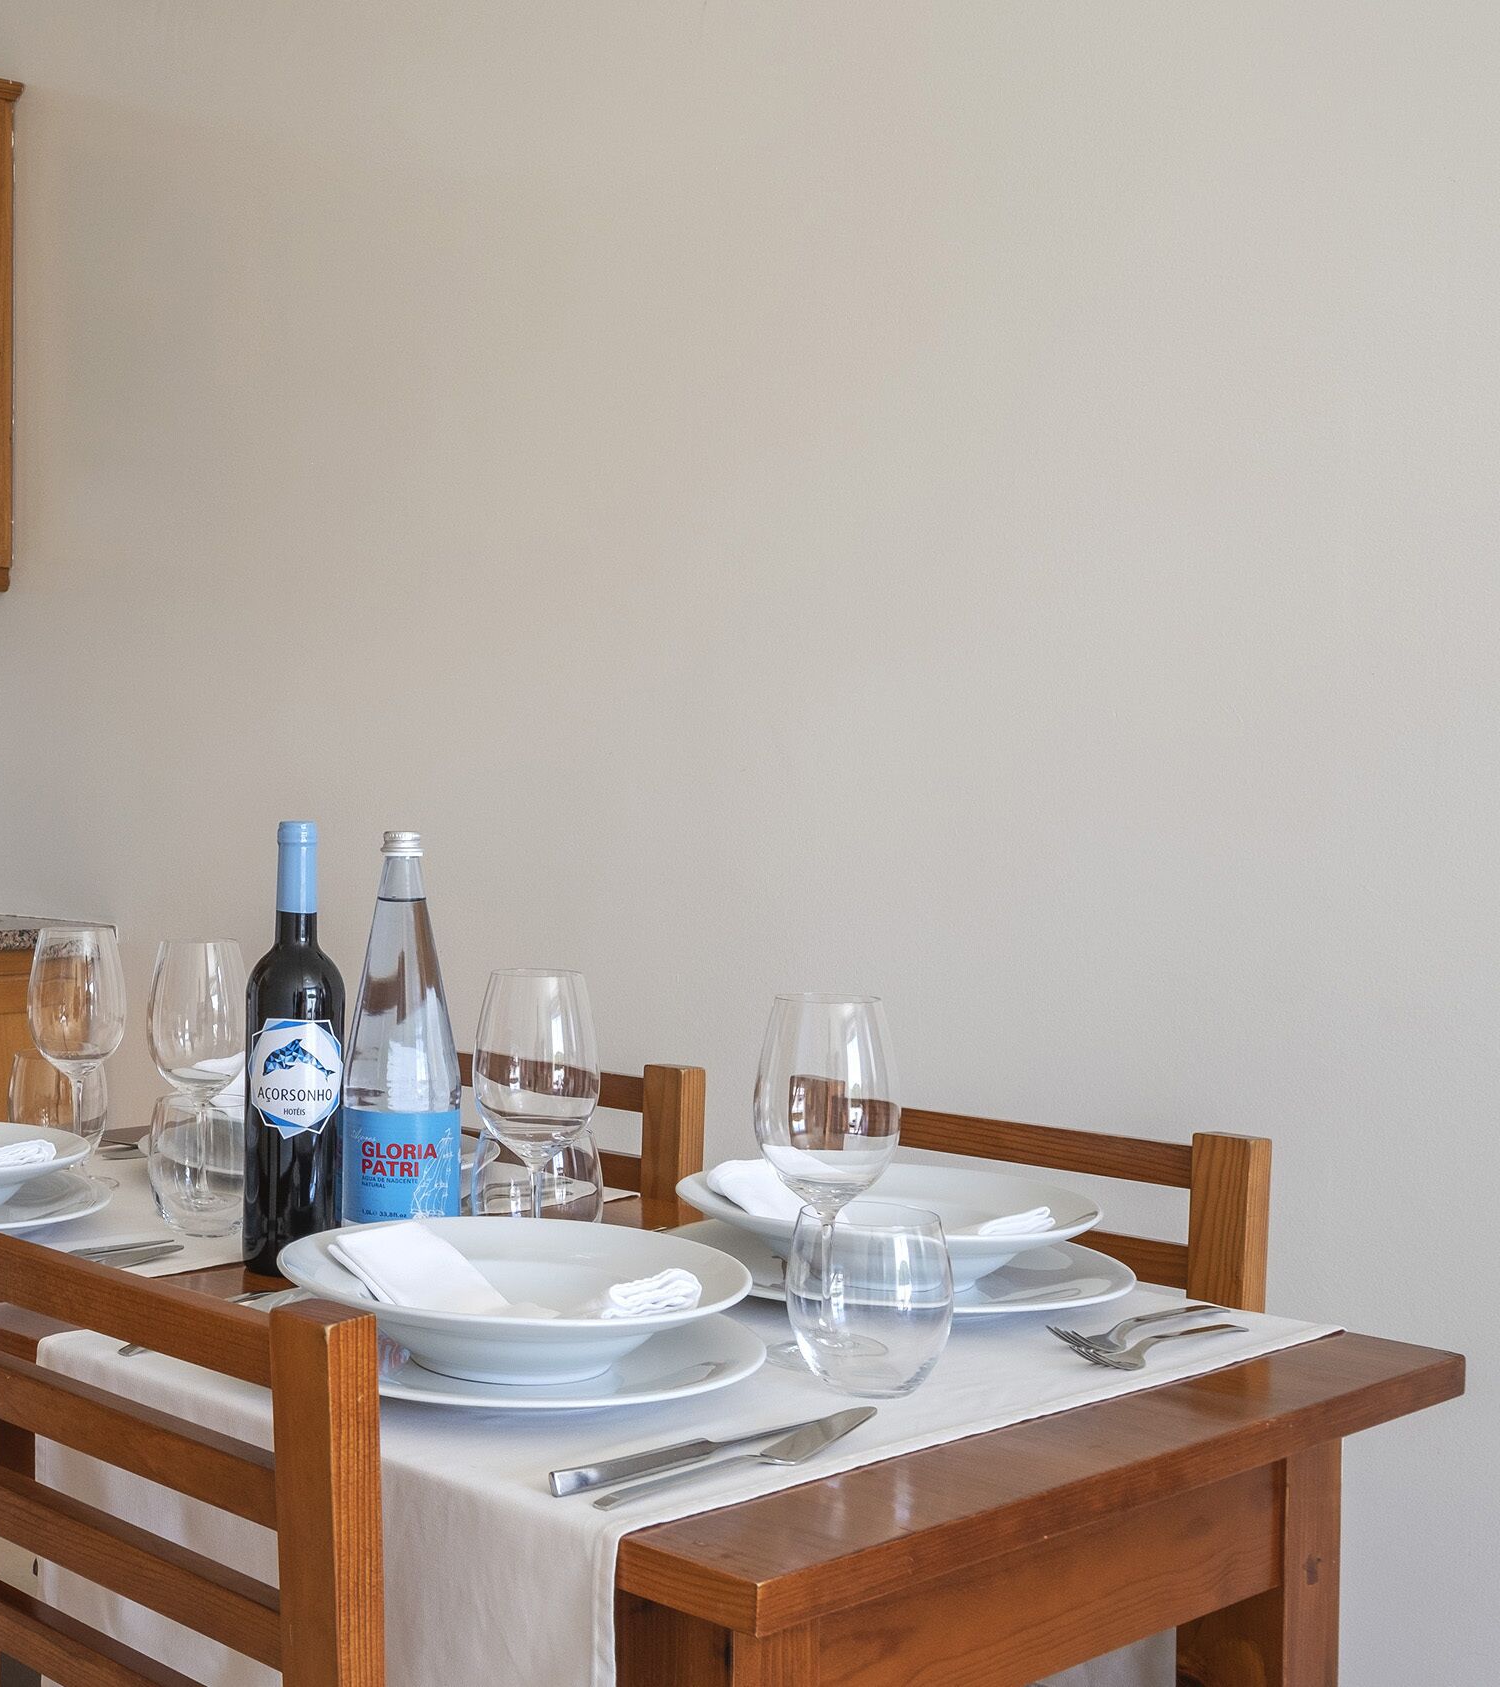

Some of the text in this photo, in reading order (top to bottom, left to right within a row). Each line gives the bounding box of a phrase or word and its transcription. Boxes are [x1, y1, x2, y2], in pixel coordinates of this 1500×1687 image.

[257, 1086, 333, 1103] AÇORSONHO
[283, 1106, 306, 1116] HOTÉIS
[361, 1141, 437, 1159] GLORIA
[361, 1158, 419, 1177] PATRI
